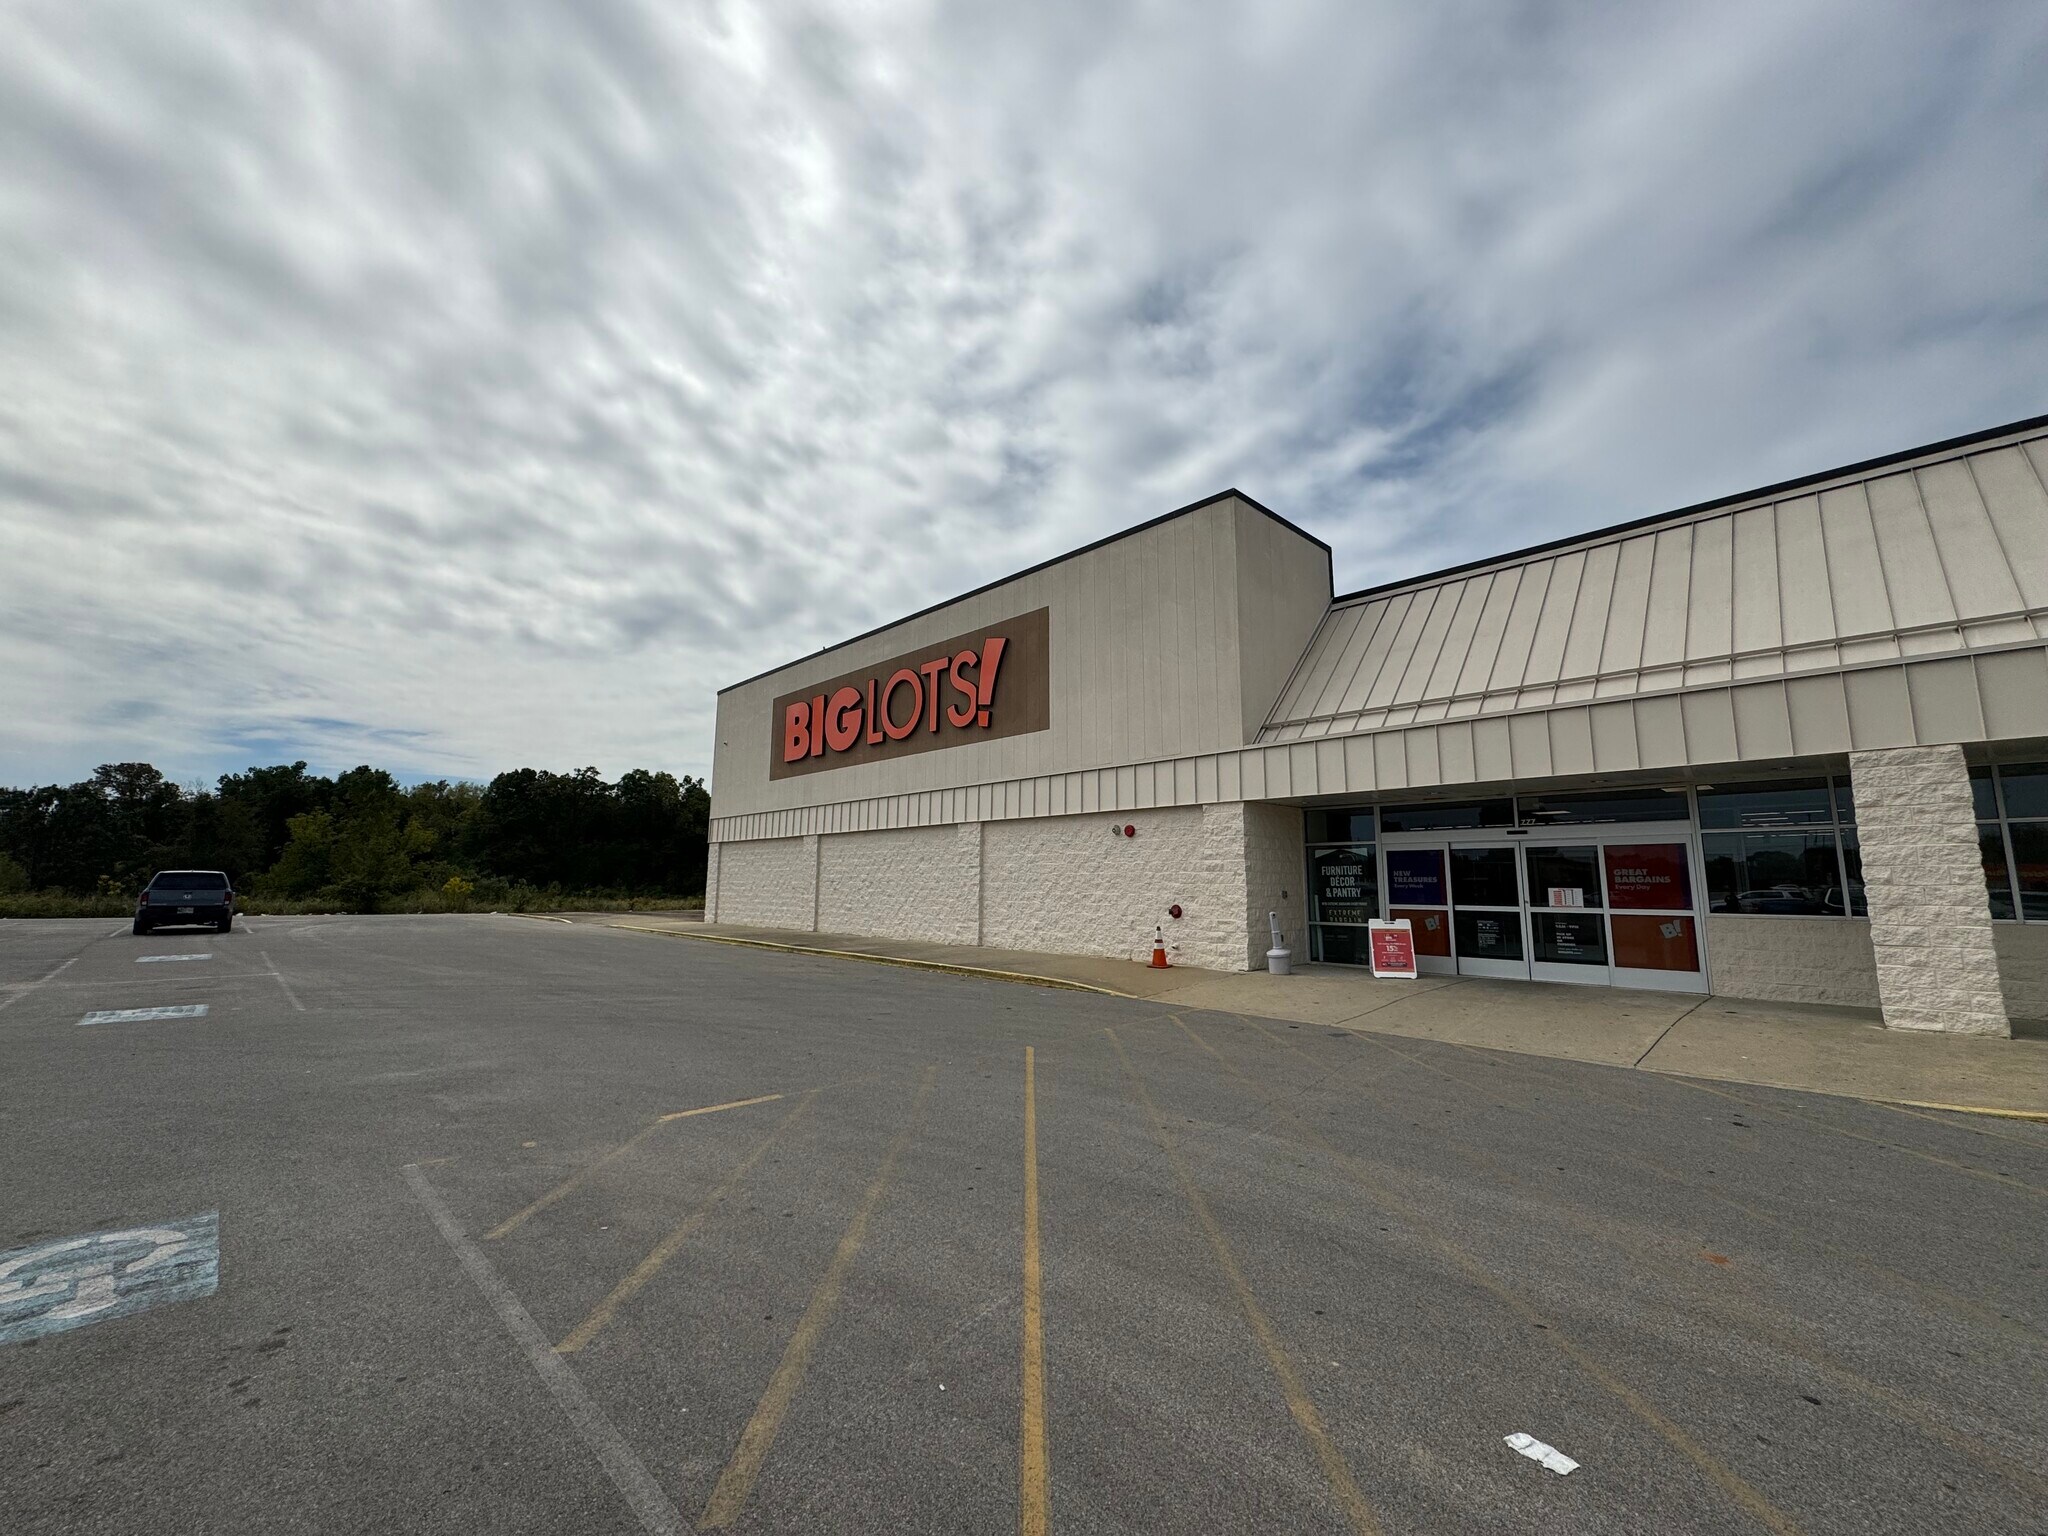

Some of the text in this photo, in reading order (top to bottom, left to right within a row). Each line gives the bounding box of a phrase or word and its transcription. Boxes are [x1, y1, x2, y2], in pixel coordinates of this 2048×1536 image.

[784, 637, 1009, 762] BIG LOTS!
[1321, 864, 1363, 876] FURNITURE
[1613, 868, 1648, 876] GREAT
[1330, 875, 1356, 887] DÉCOR
[1614, 875, 1671, 883] BARGAINS
[1325, 887, 1362, 898] & PANTRY
